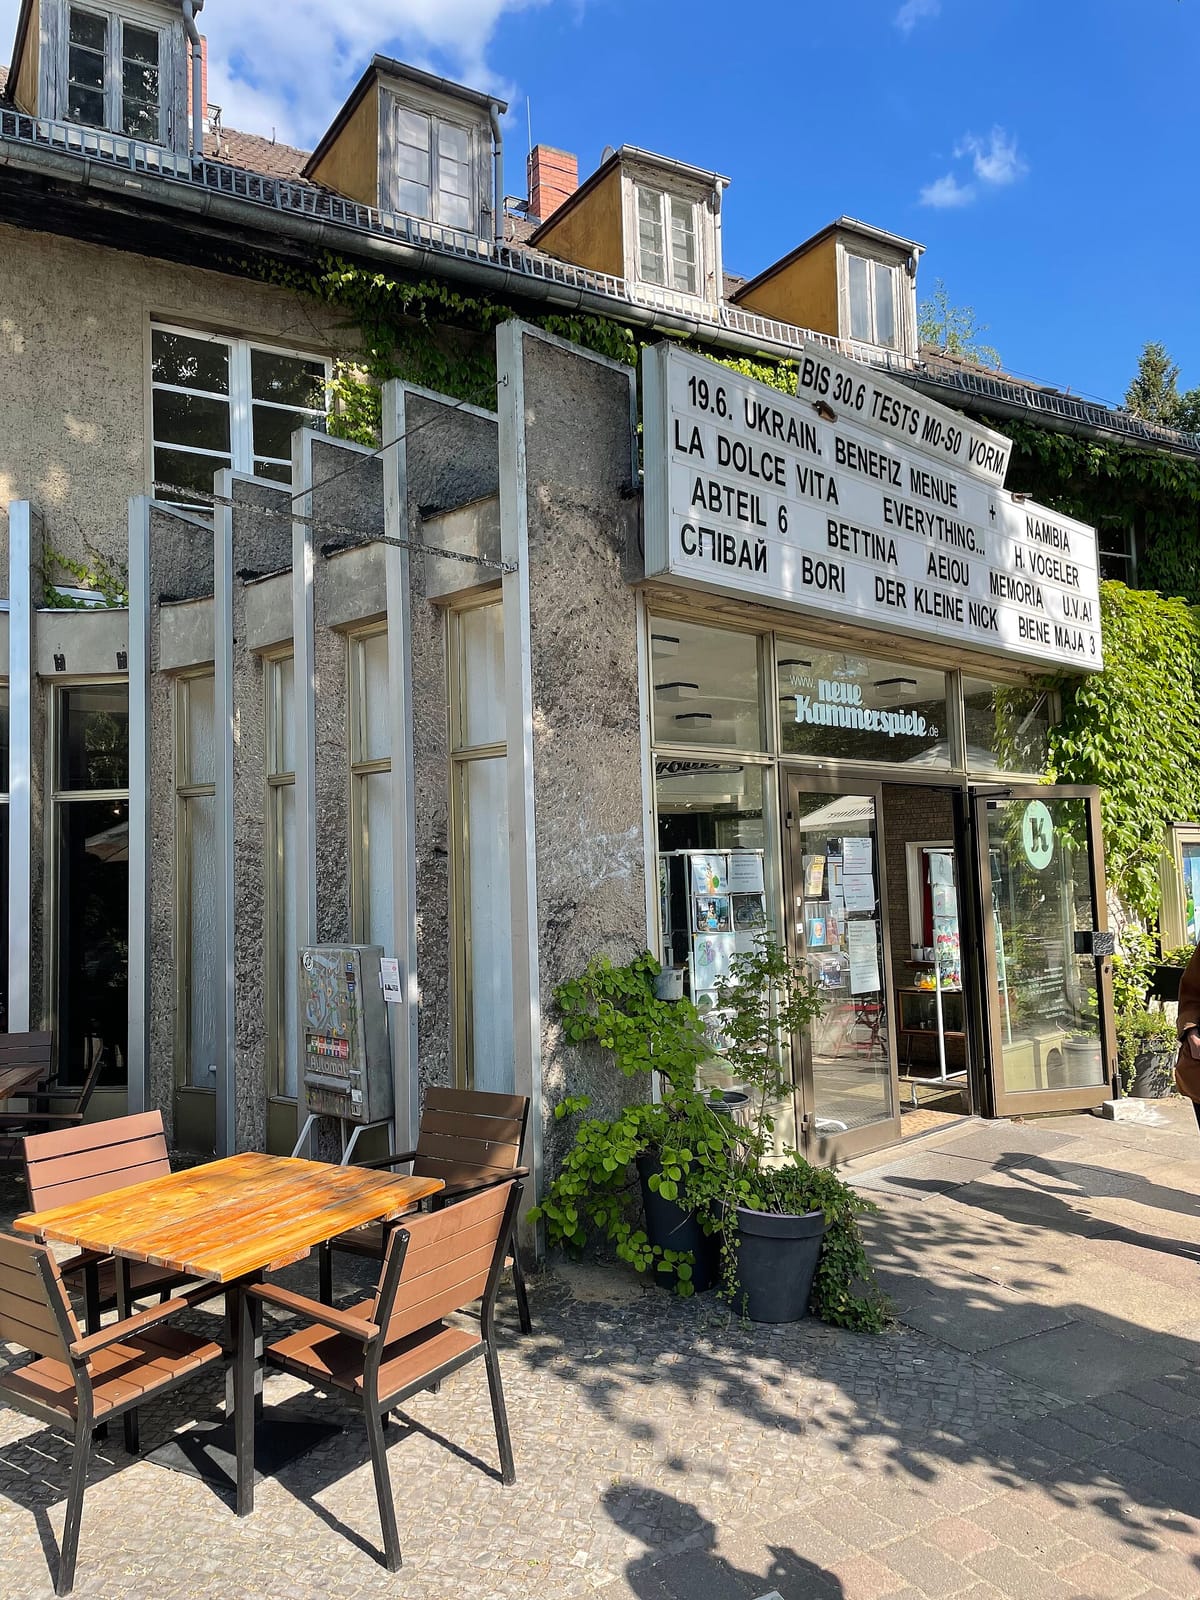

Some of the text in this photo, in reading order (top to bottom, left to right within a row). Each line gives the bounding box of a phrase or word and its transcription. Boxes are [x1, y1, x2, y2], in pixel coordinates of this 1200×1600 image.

[688, 375, 733, 421] 19.6.
[745, 398, 822, 456] UKRAIN.
[835, 436, 902, 487] BENEFIZ
[910, 467, 958, 509] MENUE
[1026, 516, 1071, 553] NAMIBIA
[801, 358, 831, 395] BIS
[833, 373, 866, 411] 30.6
[872, 390, 920, 435] TESTS
[968, 437, 1005, 476] VORM.
[675, 419, 1080, 588] LA DOLCE VITA EVERYTHING... H. VOGELER
[691, 476, 767, 527] ABTEIL
[778, 505, 788, 534] 6
[827, 519, 898, 566] BETTINA
[927, 551, 969, 587] AEIOU
[990, 571, 1044, 609] MEMORIA
[802, 556, 1096, 655] BORI DER KLEINE NICK BIENE MAJA 3
[818, 679, 863, 706] neue
